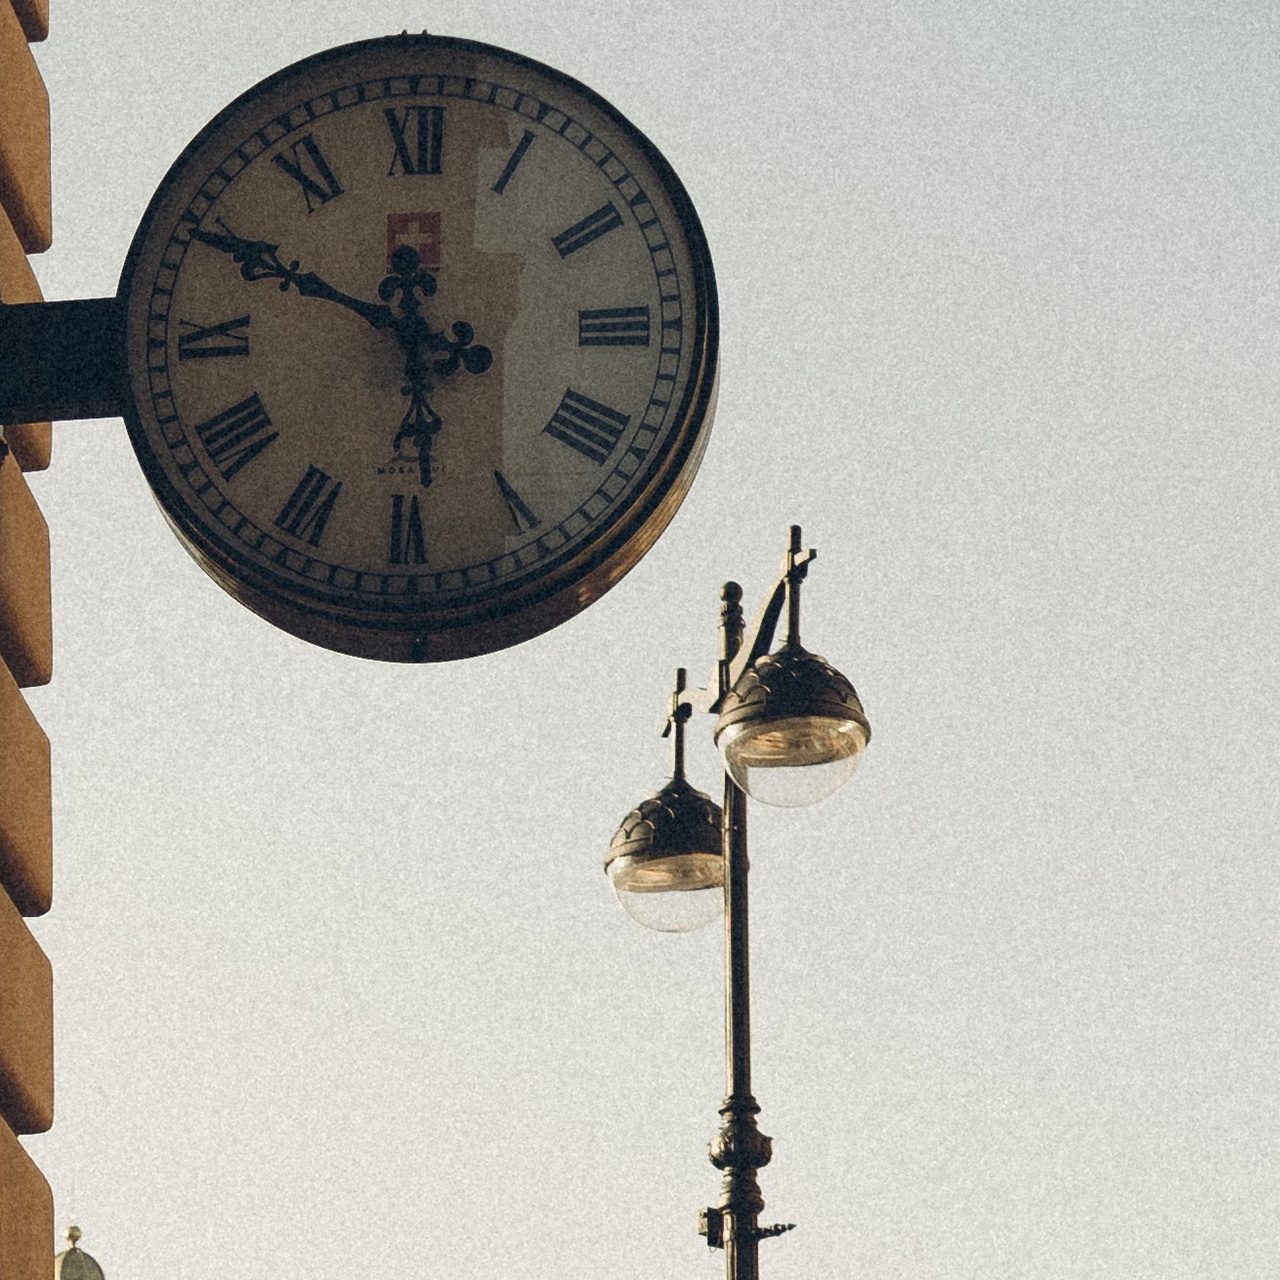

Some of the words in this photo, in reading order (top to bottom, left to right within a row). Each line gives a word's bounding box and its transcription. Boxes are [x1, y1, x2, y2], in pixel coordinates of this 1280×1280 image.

[382, 106, 447, 176] XII
[270, 133, 345, 214] XI
[551, 201, 624, 259] II
[578, 304, 650, 347] III
